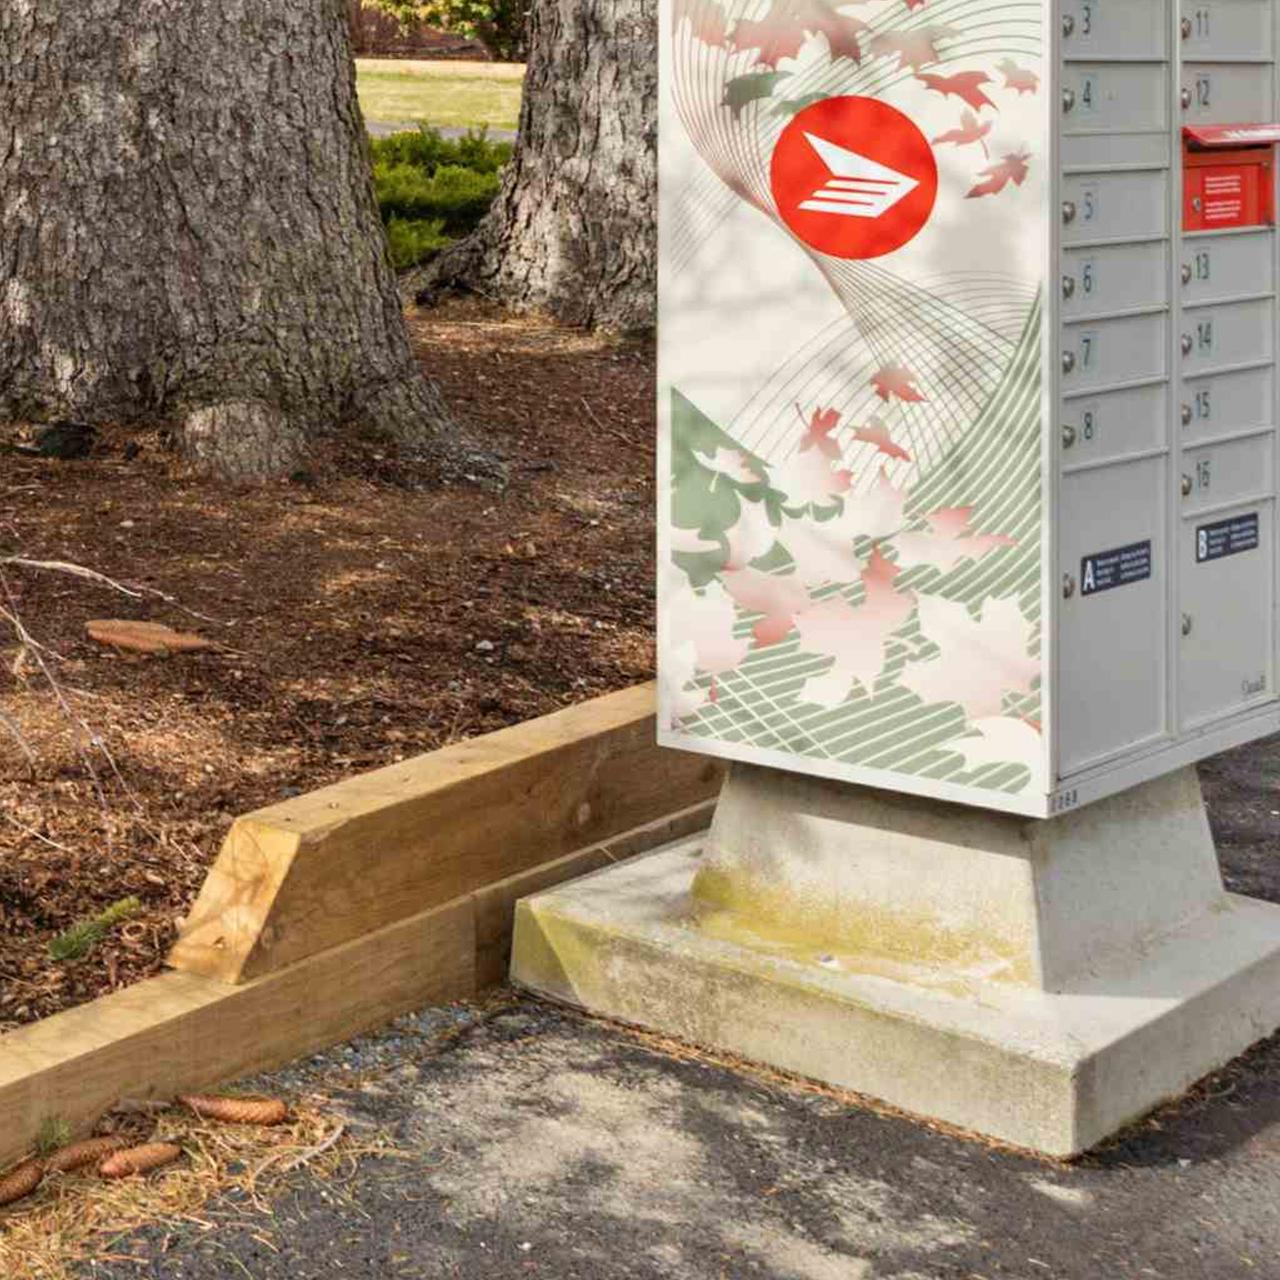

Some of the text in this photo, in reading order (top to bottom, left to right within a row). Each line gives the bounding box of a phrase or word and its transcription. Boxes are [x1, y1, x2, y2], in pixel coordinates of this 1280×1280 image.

[1083, 6, 1091, 34] 3
[1196, 10, 1209, 37] 11
[1083, 80, 1091, 107] 4
[1196, 79, 1210, 107] 12
[1083, 264, 1092, 293] 6
[1196, 253, 1210, 280] 13
[1197, 323, 1211, 349] 14
[1082, 338, 1091, 367] 7
[1196, 391, 1210, 418] 15
[1084, 412, 1093, 440] 8
[1198, 530, 1208, 558] B
[1083, 560, 1096, 590] A
